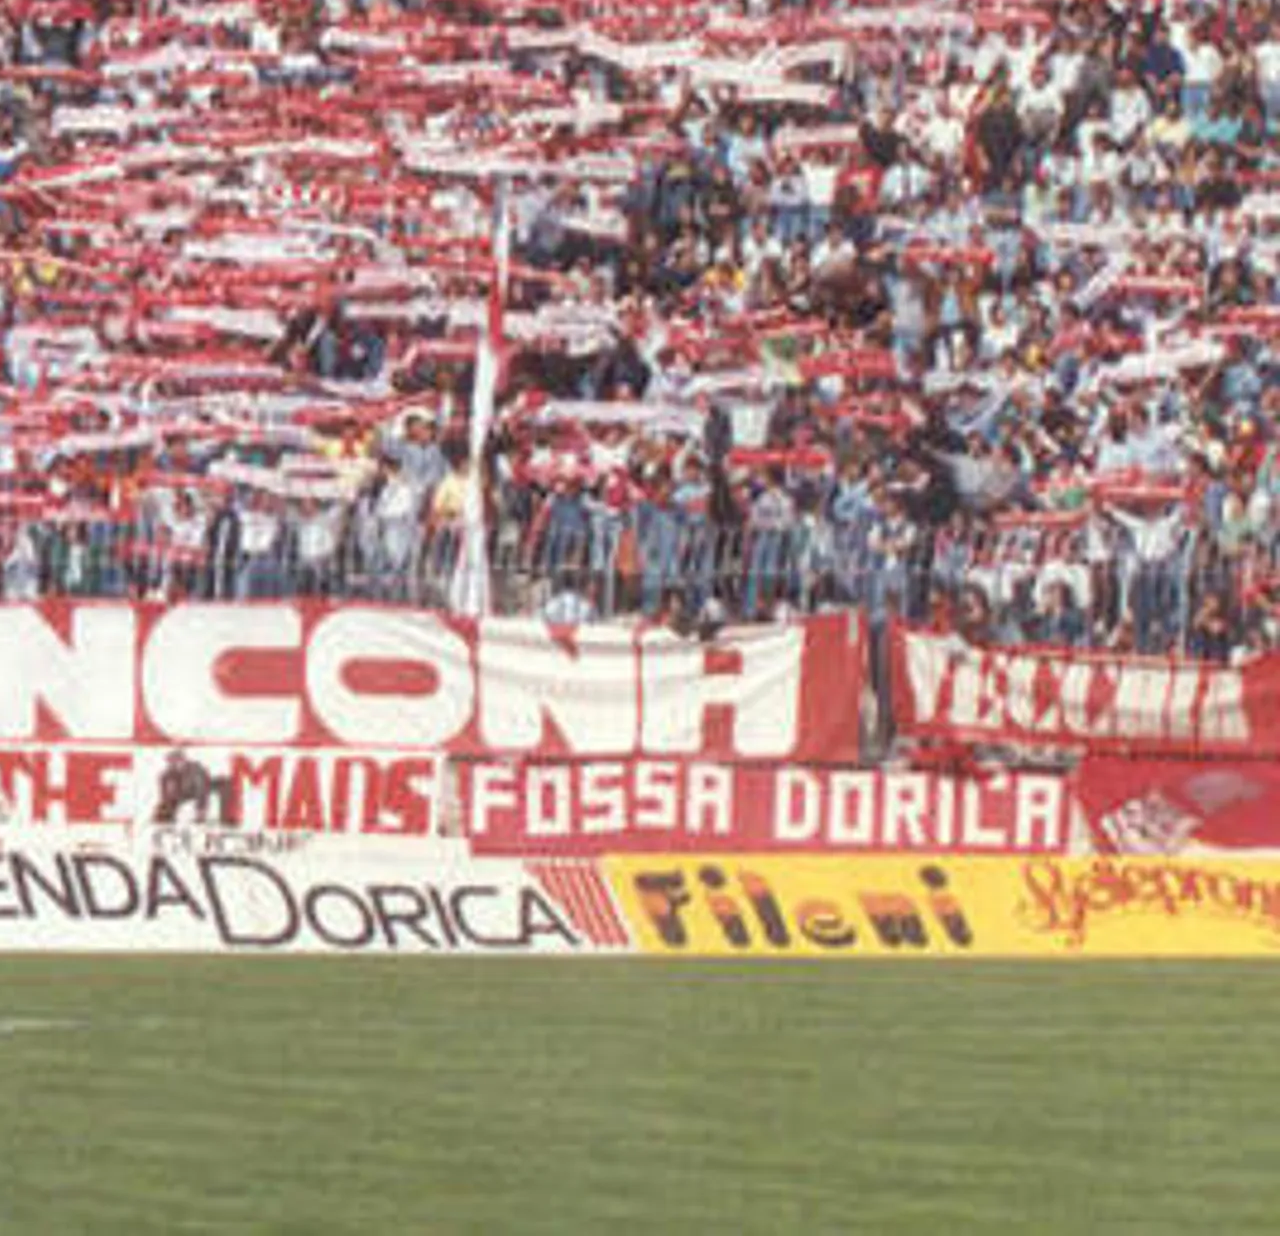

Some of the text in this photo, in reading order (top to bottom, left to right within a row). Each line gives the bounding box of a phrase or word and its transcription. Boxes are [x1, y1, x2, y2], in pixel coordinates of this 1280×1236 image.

[470, 765, 1065, 847] FOSSA DORICA
[633, 864, 974, 948] Fileni
